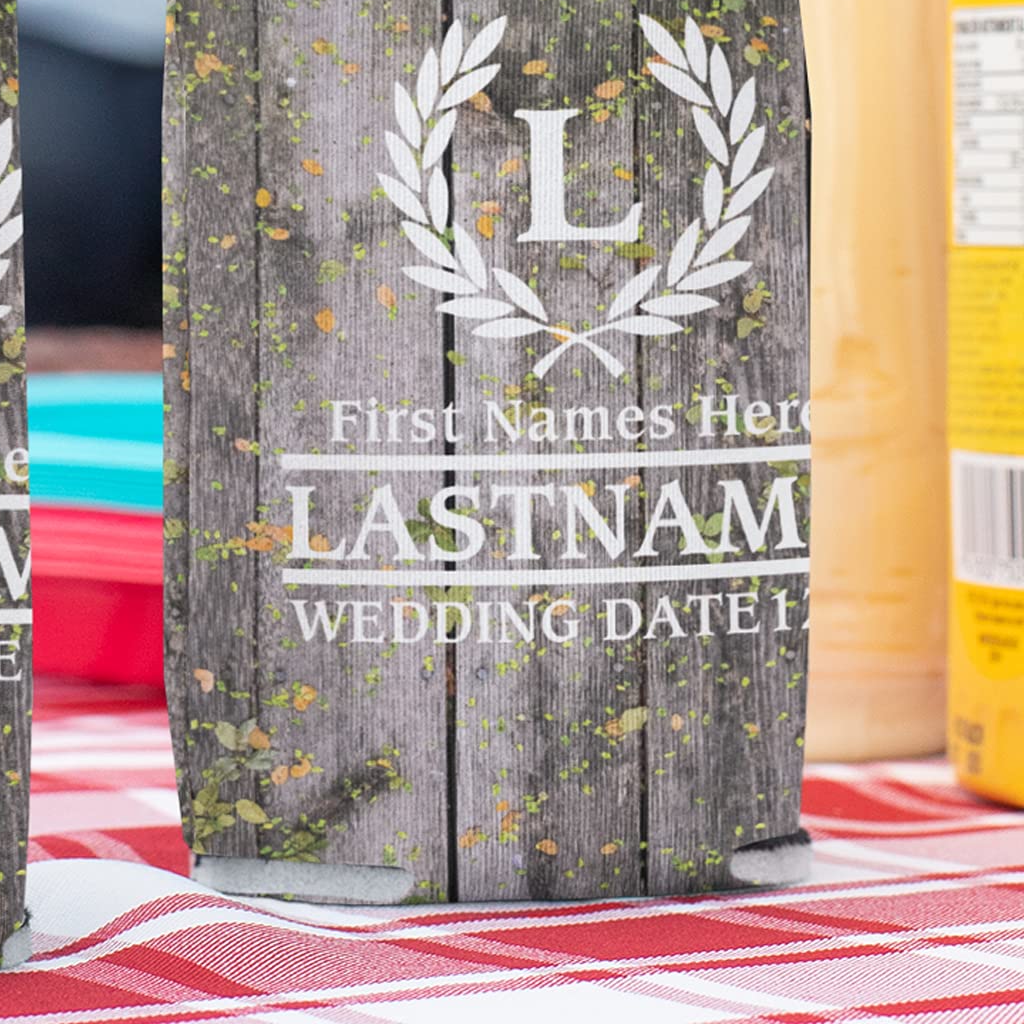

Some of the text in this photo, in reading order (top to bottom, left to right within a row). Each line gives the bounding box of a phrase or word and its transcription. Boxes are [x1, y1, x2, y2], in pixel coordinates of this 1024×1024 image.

[514, 108, 643, 242] L
[330, 398, 459, 444] First
[483, 398, 676, 443] Names
[285, 476, 807, 561] LASTNAM
[292, 596, 579, 644] WEDDING
[603, 591, 761, 642] DATE
